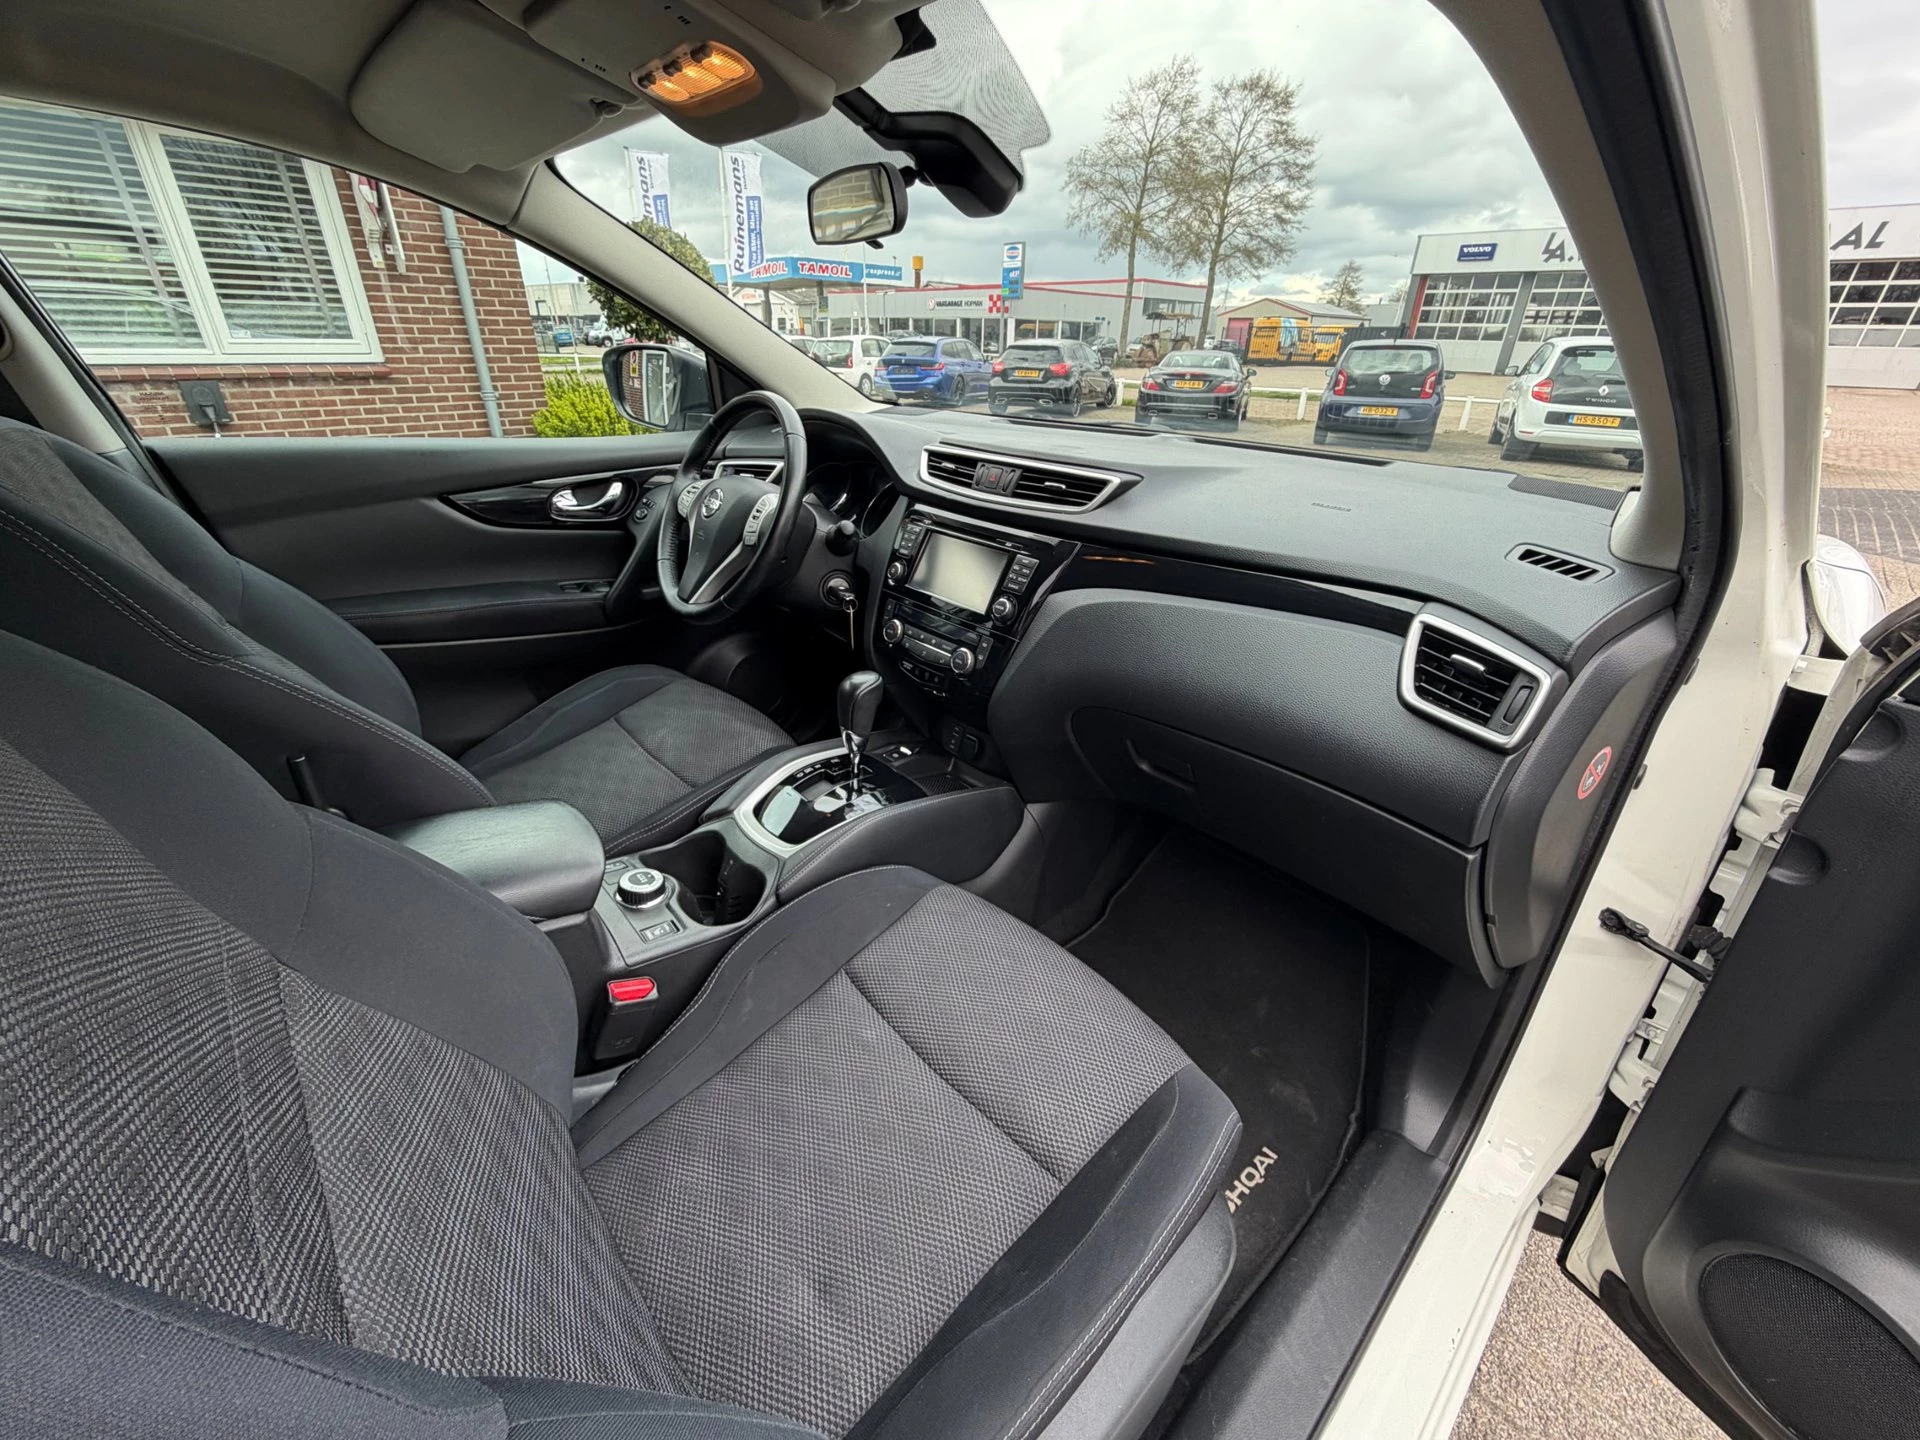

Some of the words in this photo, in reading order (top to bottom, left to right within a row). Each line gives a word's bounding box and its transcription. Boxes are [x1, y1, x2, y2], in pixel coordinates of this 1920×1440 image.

[637, 156, 653, 216] mans
[731, 156, 745, 272] Ruinemans
[1829, 221, 1889, 251] AL
[799, 262, 852, 277] TAMOIL
